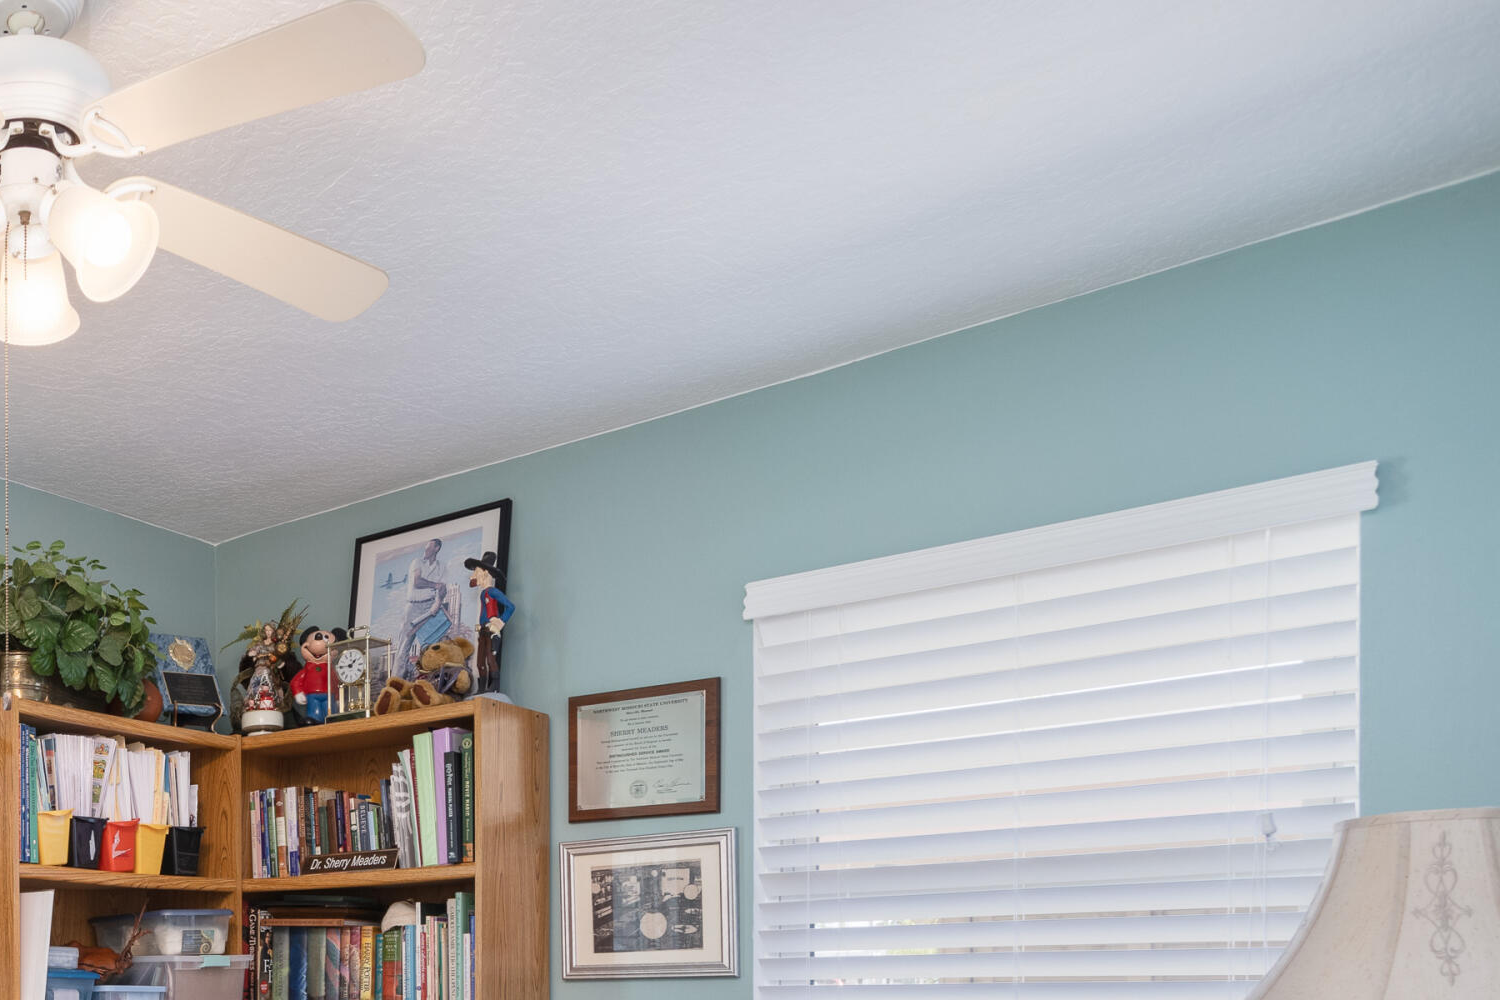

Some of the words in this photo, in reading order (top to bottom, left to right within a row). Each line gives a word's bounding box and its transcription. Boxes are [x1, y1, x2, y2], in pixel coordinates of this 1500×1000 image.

[637, 724, 668, 735] MEADERS
[359, 805, 367, 834] BELIEVE
[310, 858, 322, 870] Dr.
[324, 857, 351, 870] Sherry
[351, 854, 387, 867] Meaders
[363, 967, 371, 993] POTTER
